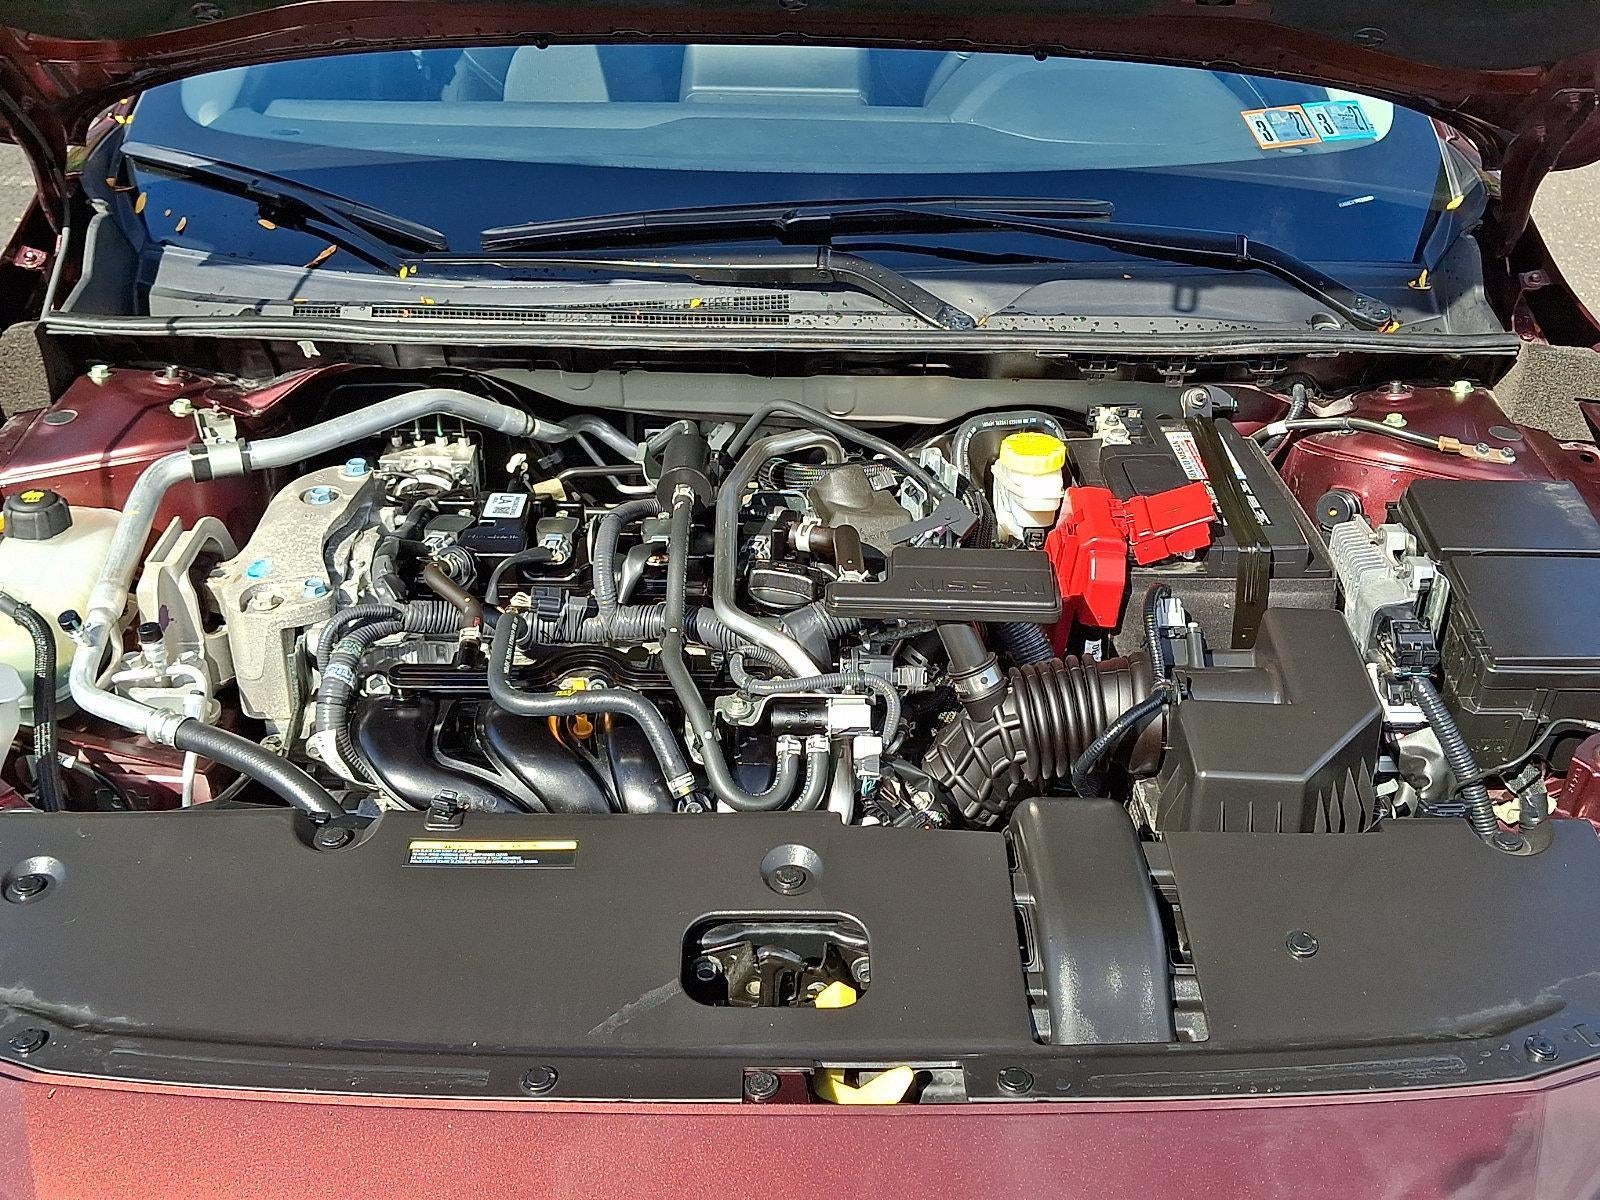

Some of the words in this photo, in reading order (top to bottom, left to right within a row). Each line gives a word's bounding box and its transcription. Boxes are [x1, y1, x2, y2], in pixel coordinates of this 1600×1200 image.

[1288, 111, 1311, 136] 27
[1316, 113, 1334, 134] 3
[1347, 105, 1369, 130] 27
[1256, 120, 1274, 141] 3
[909, 578, 1045, 594] NISSAN
